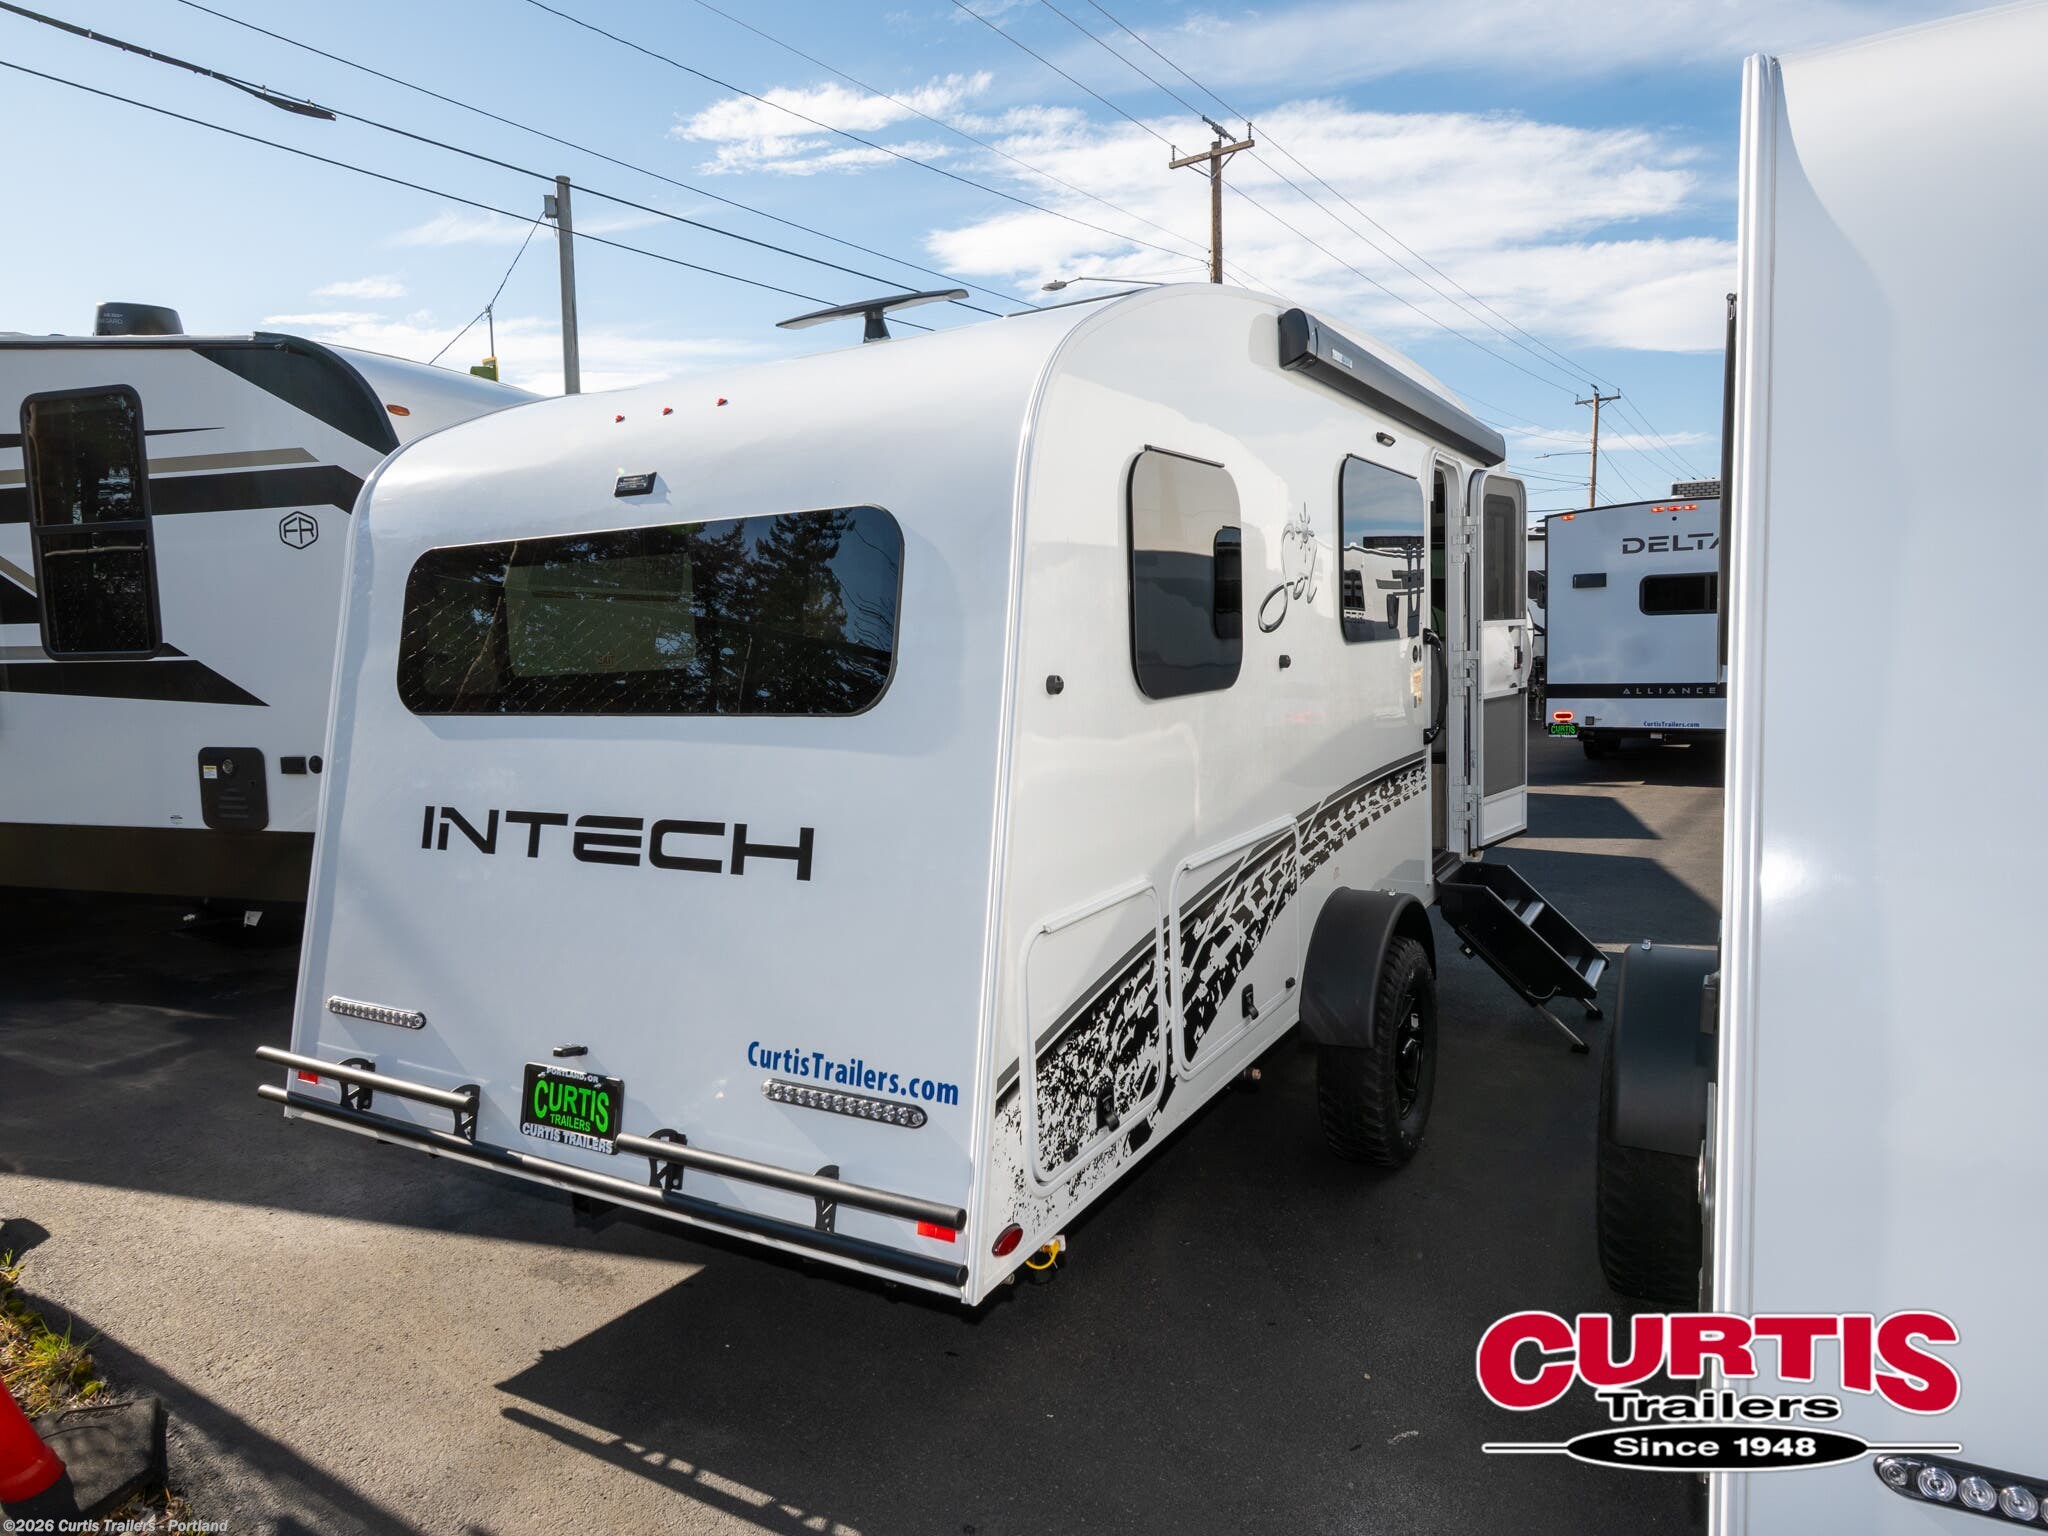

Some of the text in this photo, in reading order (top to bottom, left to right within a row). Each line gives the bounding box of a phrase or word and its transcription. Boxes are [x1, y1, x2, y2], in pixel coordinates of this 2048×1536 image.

[1622, 686, 1717, 695] ALLIANCE
[1550, 725, 1576, 735] CURTIS
[1643, 720, 1700, 728] CurtisTrailers.com
[421, 805, 815, 881] INTECH
[747, 1041, 960, 1106] CurtisTrailers.com
[534, 1079, 610, 1133] CURTIS
[550, 1113, 591, 1132] TRAILERS
[522, 1122, 613, 1155] CURTIS TRAILERS
